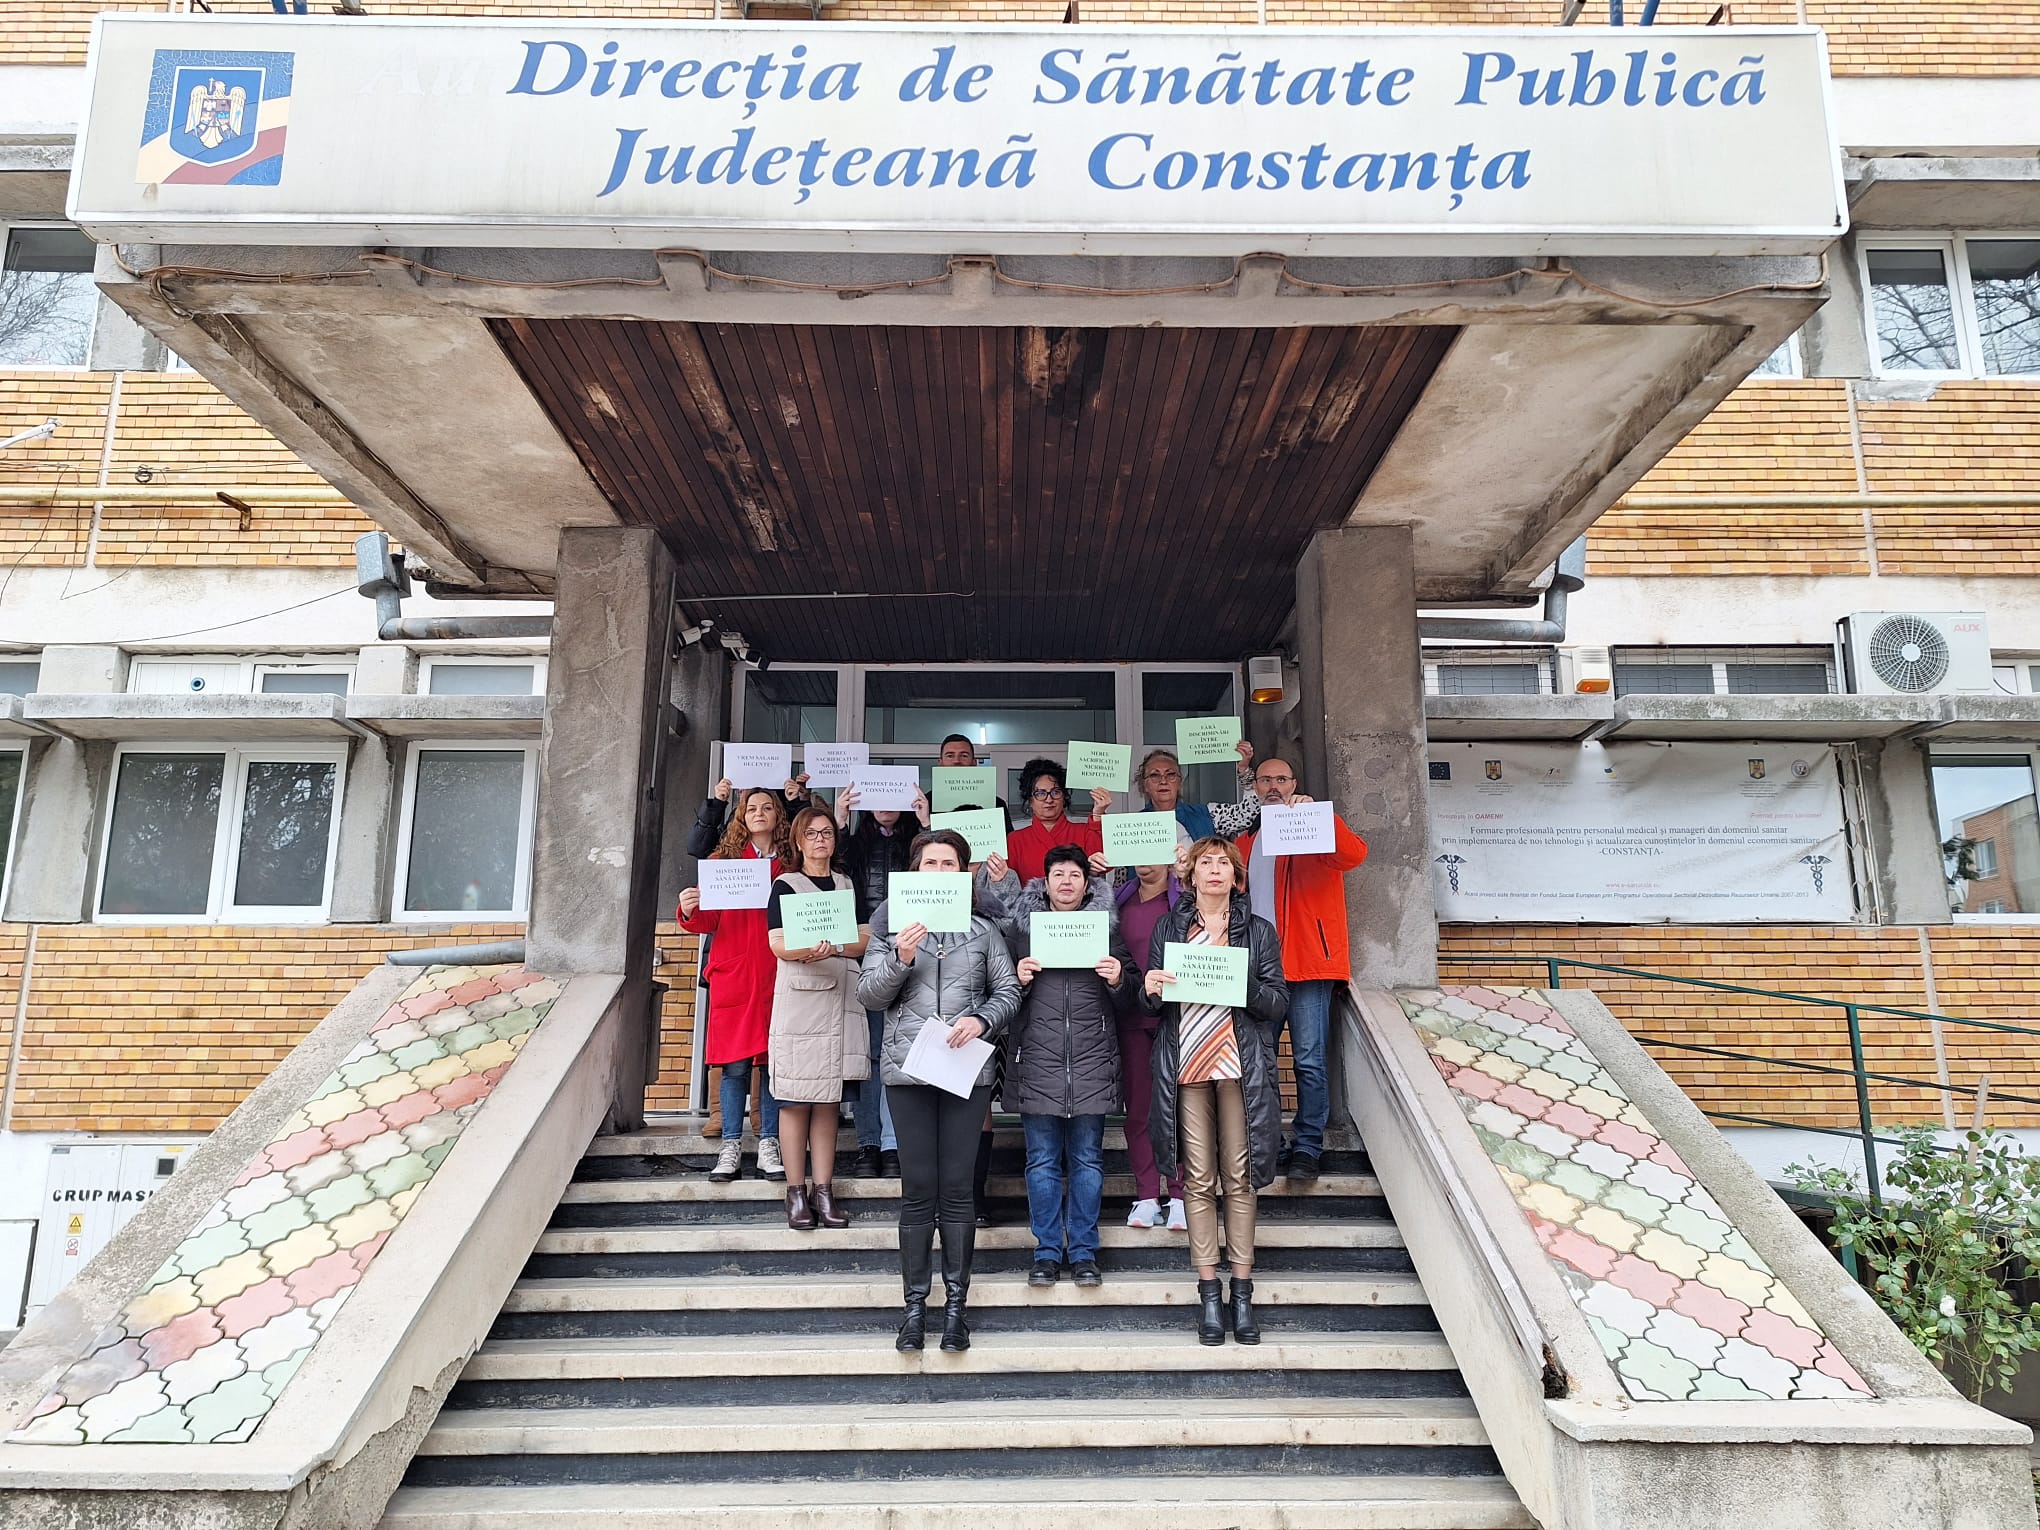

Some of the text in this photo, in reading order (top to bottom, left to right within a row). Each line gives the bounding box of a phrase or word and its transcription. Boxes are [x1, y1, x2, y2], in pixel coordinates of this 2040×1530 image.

[506, 41, 862, 120] Direcția
[899, 45, 993, 102] de
[1088, 133, 1532, 211] Constanța
[1953, 624, 1981, 632] AUX
[1470, 826, 1504, 835] Formare
[1505, 826, 1554, 837] profesională
[1556, 827, 1582, 837] pentru
[1583, 826, 1625, 837] personalul
[1626, 826, 1658, 835] medical
[1669, 826, 1706, 837] manageri
[1707, 826, 1721, 834] din
[1722, 826, 1760, 834] domeniul
[1761, 826, 1788, 834] sanitar
[1441, 837, 1457, 846] prin
[1458, 837, 1516, 846] implementarea
[1518, 836, 1528, 845] de
[1529, 837, 1543, 845] noi
[1544, 836, 1584, 847] tehnologii
[1595, 836, 1643, 845] actualizarea
[1708, 836, 1745, 845] domeniul
[1747, 837, 1788, 845] economiei
[1183, 954, 1229, 963] MINISTERUL
[53, 1190, 102, 1202] GRUP
